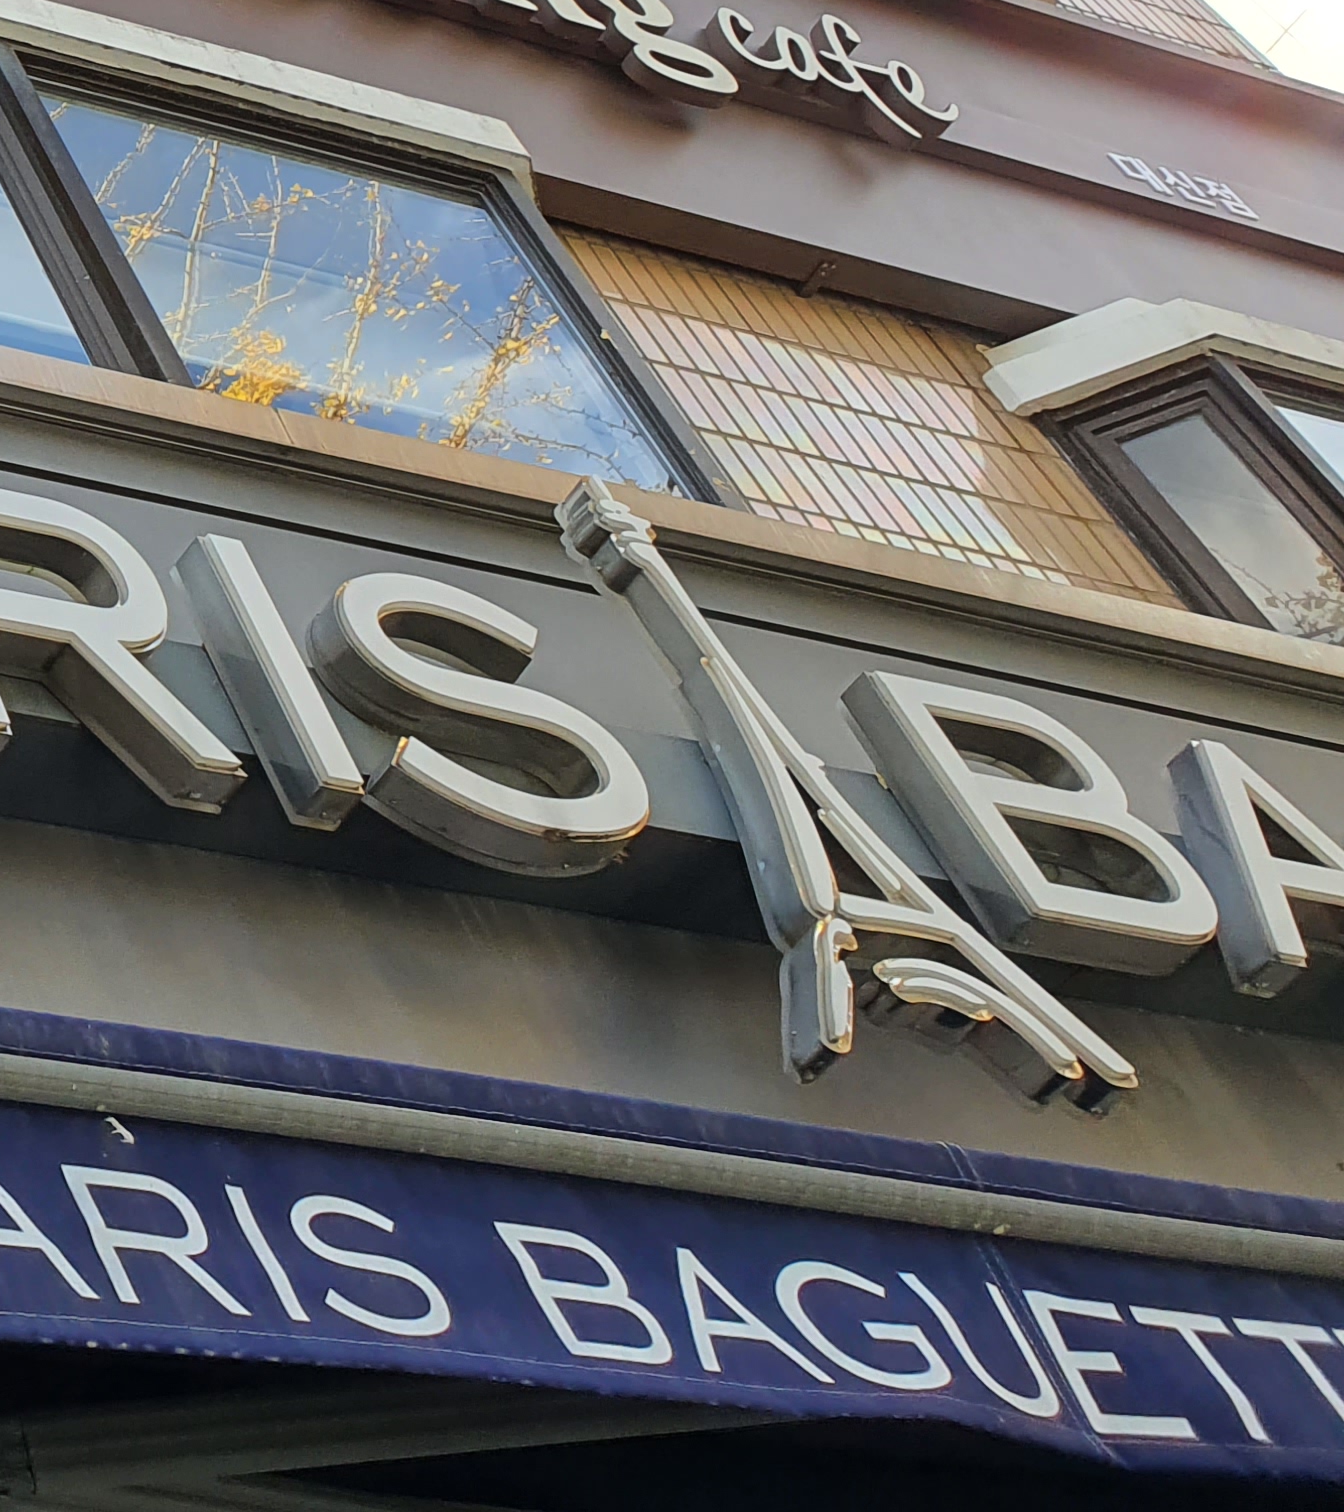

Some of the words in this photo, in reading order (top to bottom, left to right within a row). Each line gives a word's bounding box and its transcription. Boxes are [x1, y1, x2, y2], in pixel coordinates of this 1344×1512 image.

[716, 6, 960, 140] cafe
[1105, 151, 1261, 221] 대신점
[493, 1220, 1344, 1446] BAGUETT
